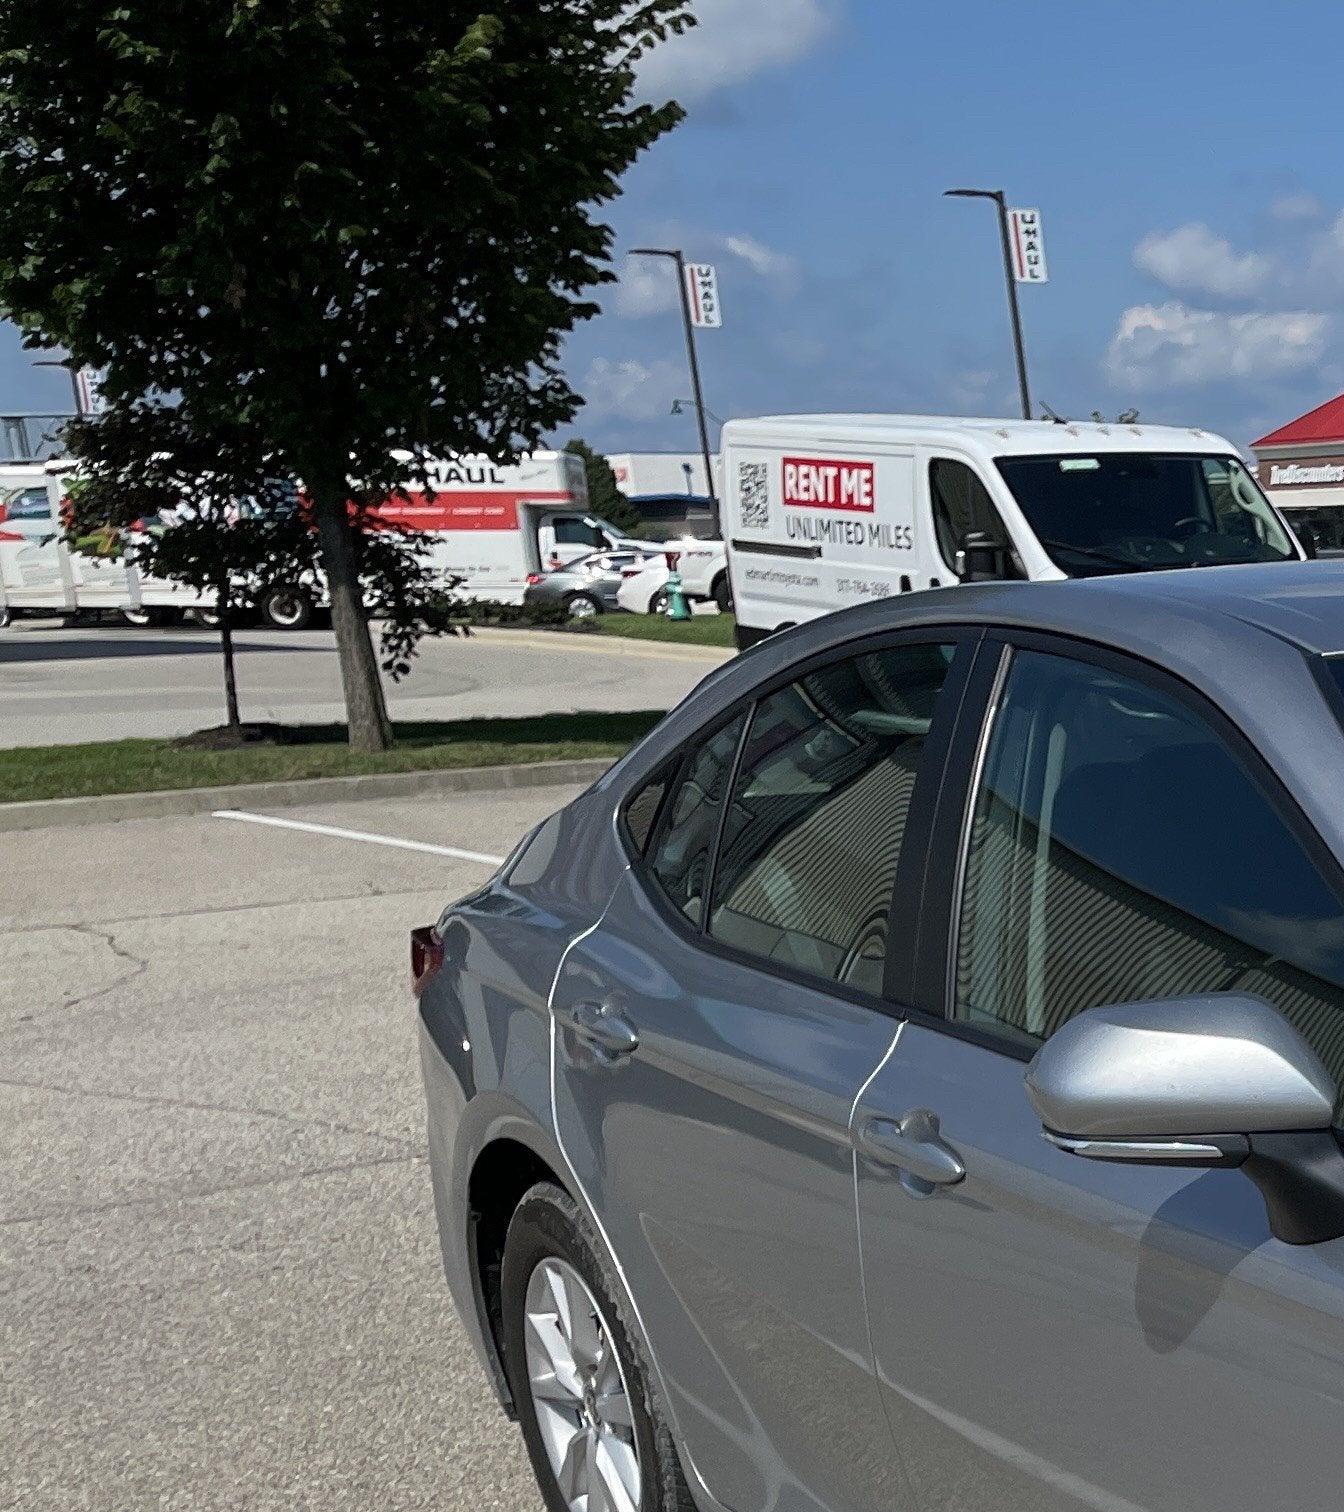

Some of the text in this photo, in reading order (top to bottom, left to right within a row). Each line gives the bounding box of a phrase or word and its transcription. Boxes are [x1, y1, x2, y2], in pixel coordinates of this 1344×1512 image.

[427, 467, 505, 484] HAUL
[784, 463, 873, 507] RENT ME
[785, 514, 913, 550] UNLIMITED MILES
